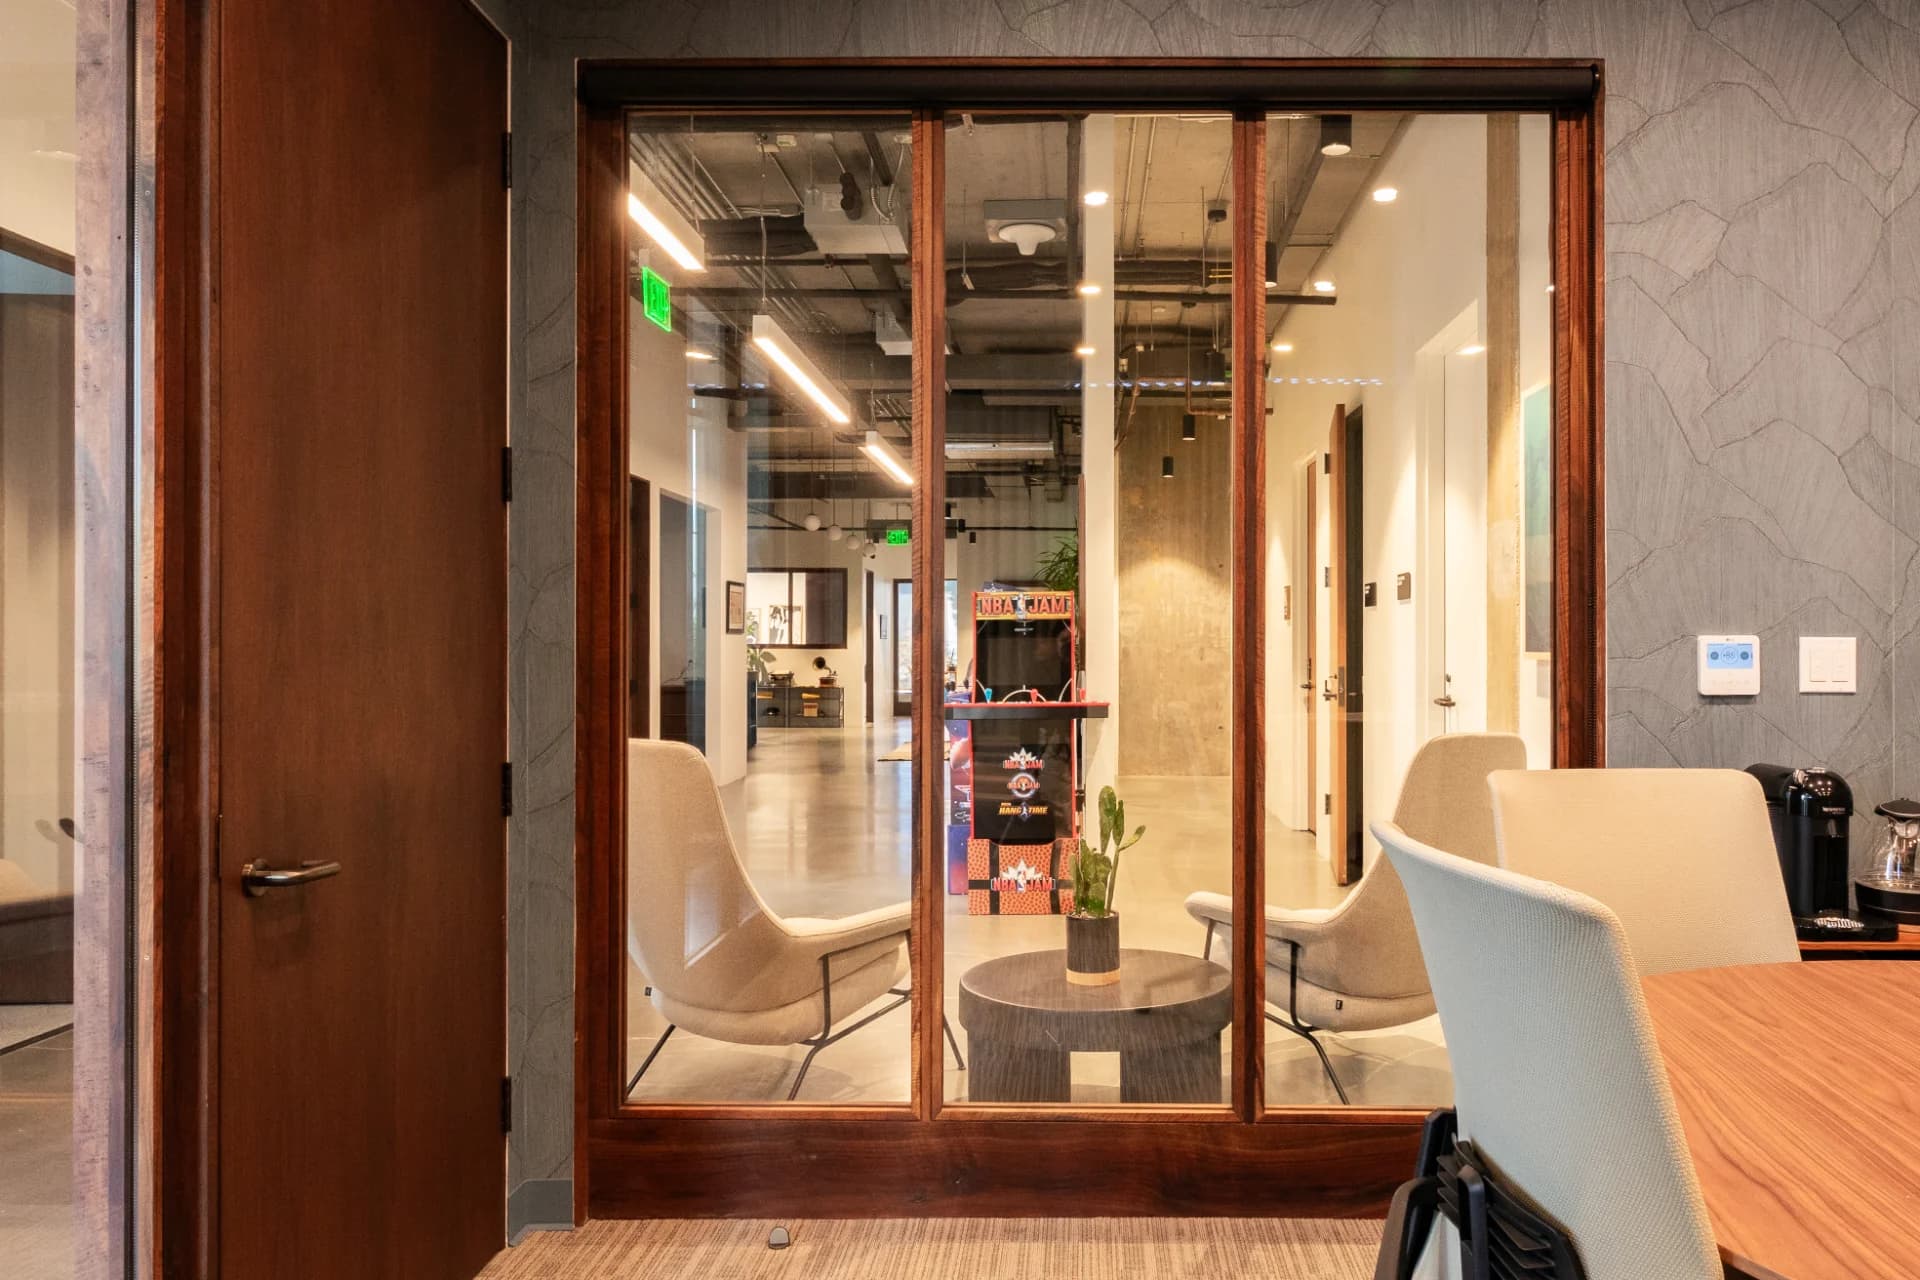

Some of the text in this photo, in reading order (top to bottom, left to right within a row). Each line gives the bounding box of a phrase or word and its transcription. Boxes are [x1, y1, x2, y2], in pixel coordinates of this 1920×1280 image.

[981, 595, 1066, 614] NBA JAM
[1026, 760, 1043, 769] JAM
[999, 806, 1048, 816] HANG TIME
[993, 877, 1053, 892] NBA JAM
